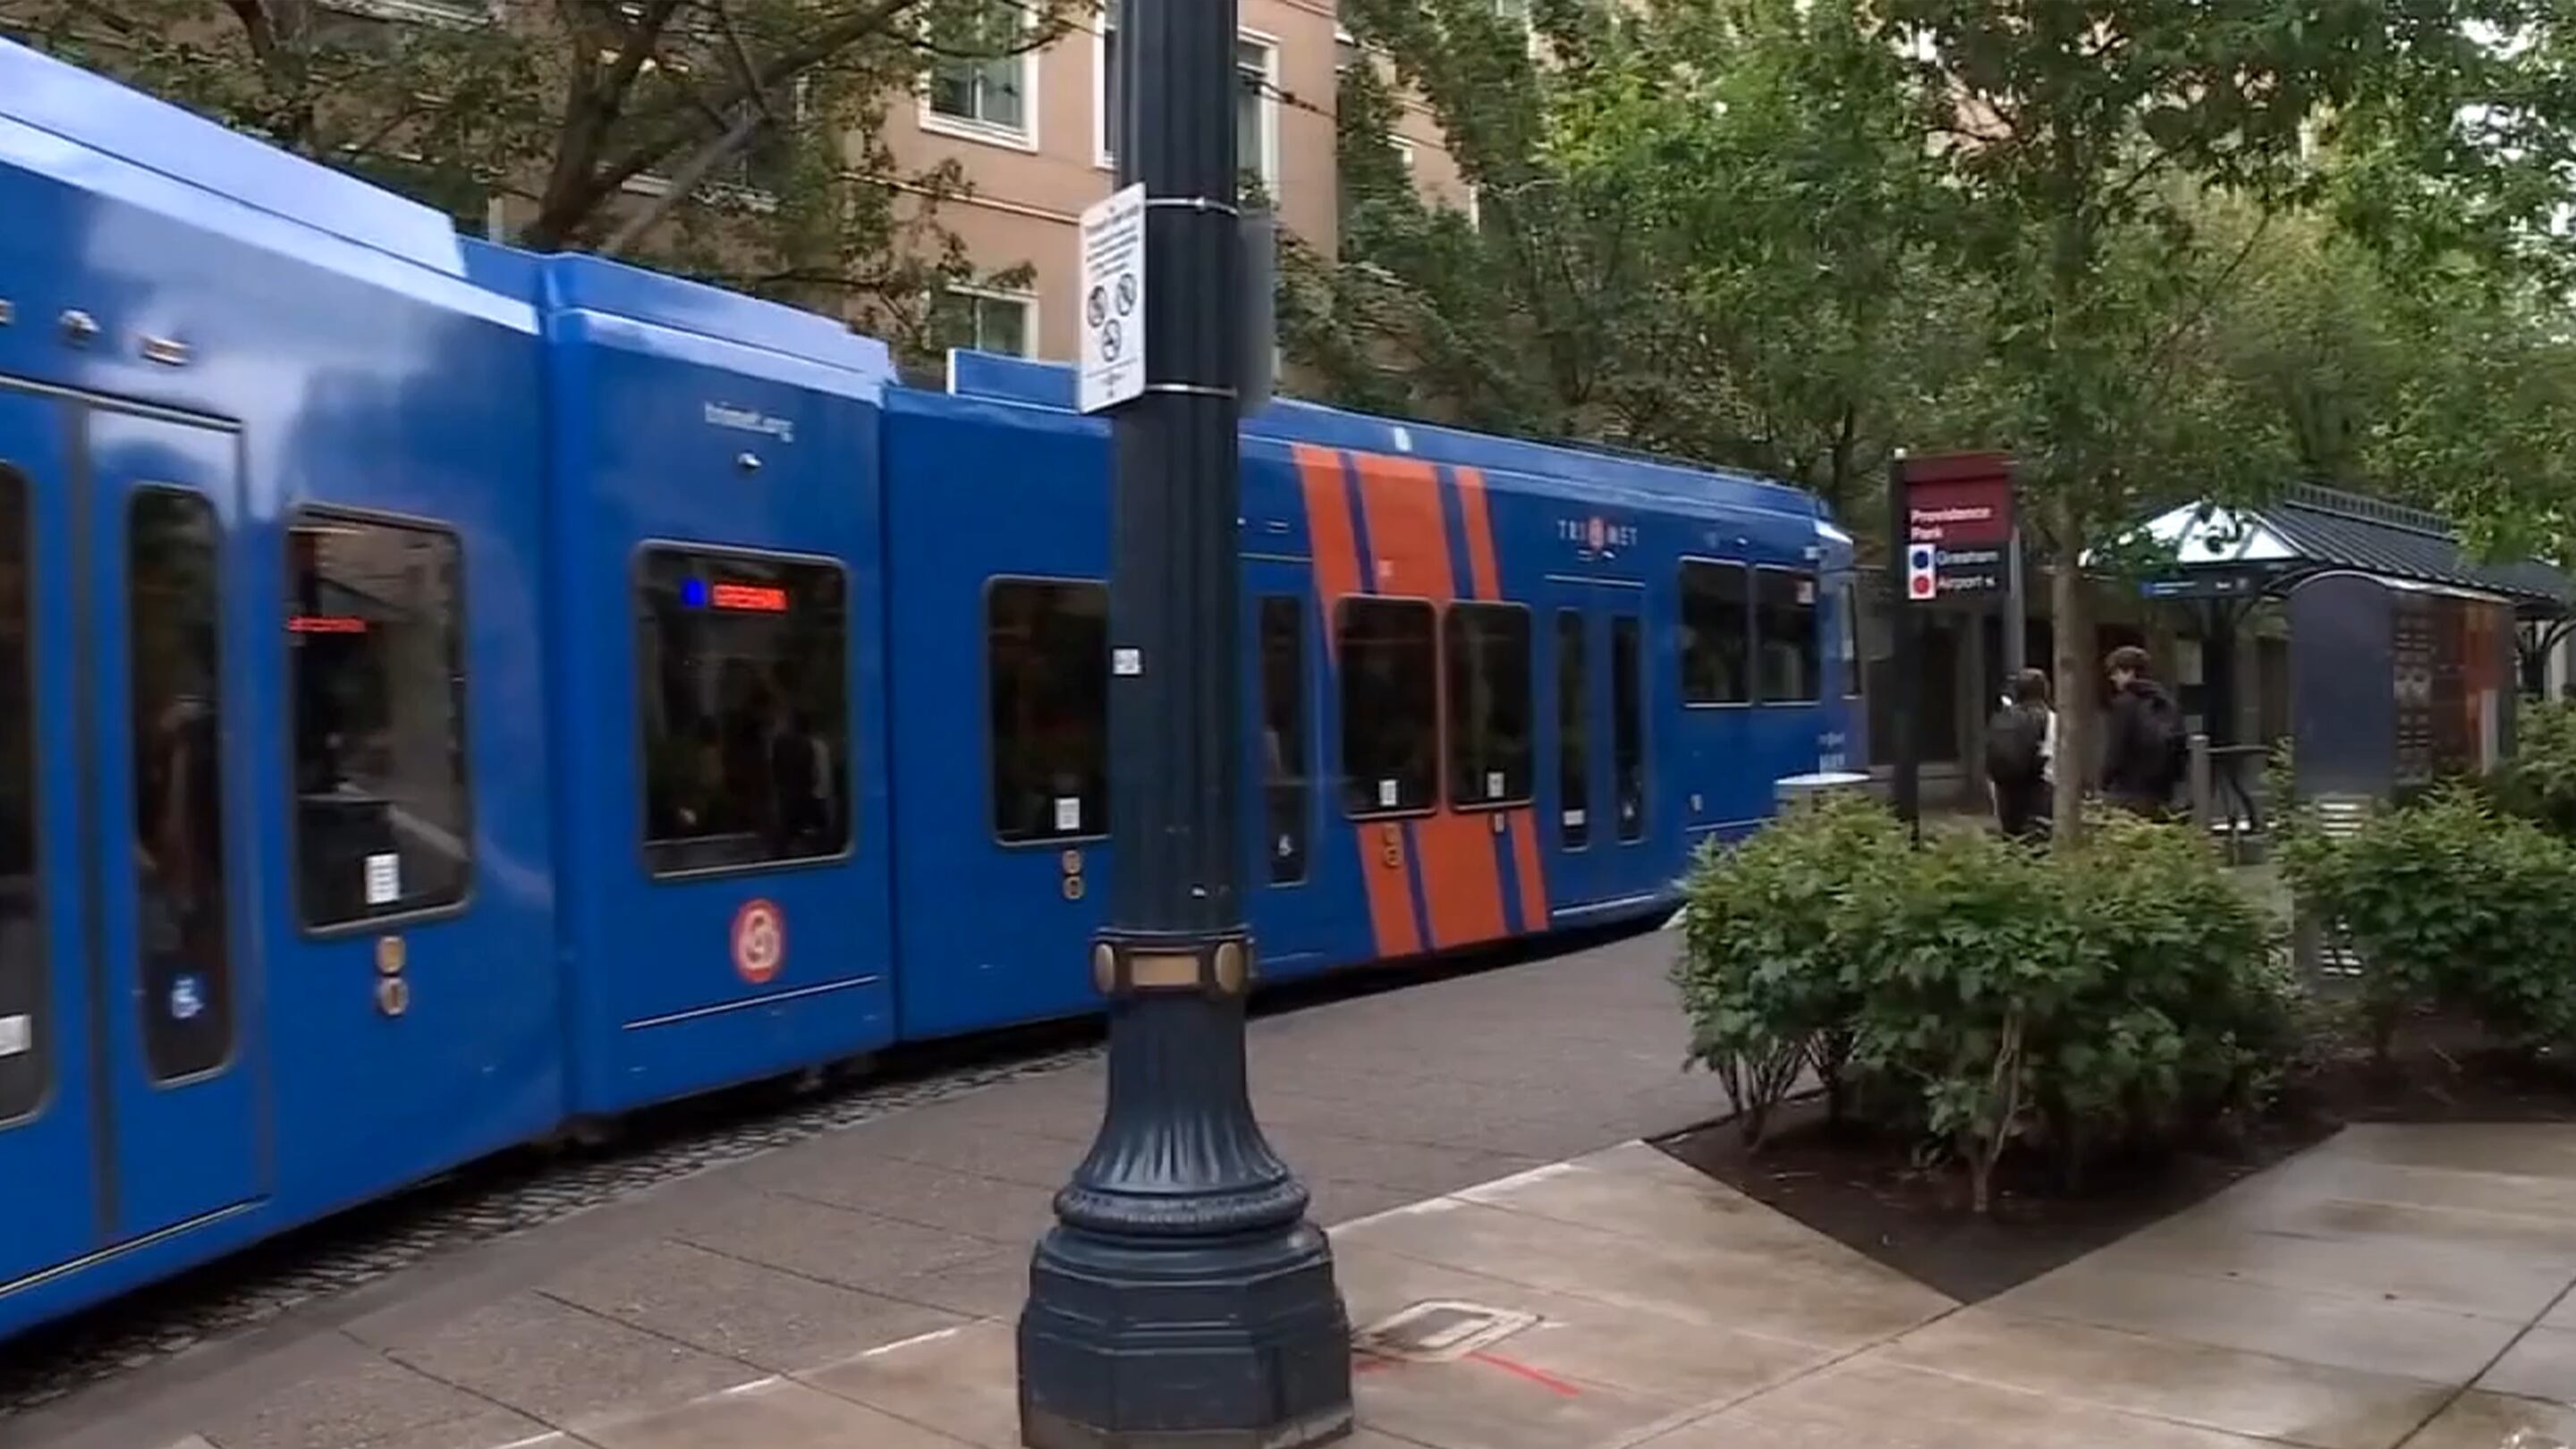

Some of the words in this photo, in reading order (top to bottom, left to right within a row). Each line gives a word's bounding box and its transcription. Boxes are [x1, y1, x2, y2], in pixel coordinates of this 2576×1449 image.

[1910, 507, 1991, 523] Providence
[1910, 526, 1944, 540] Park
[1937, 576, 1983, 590] Airport
